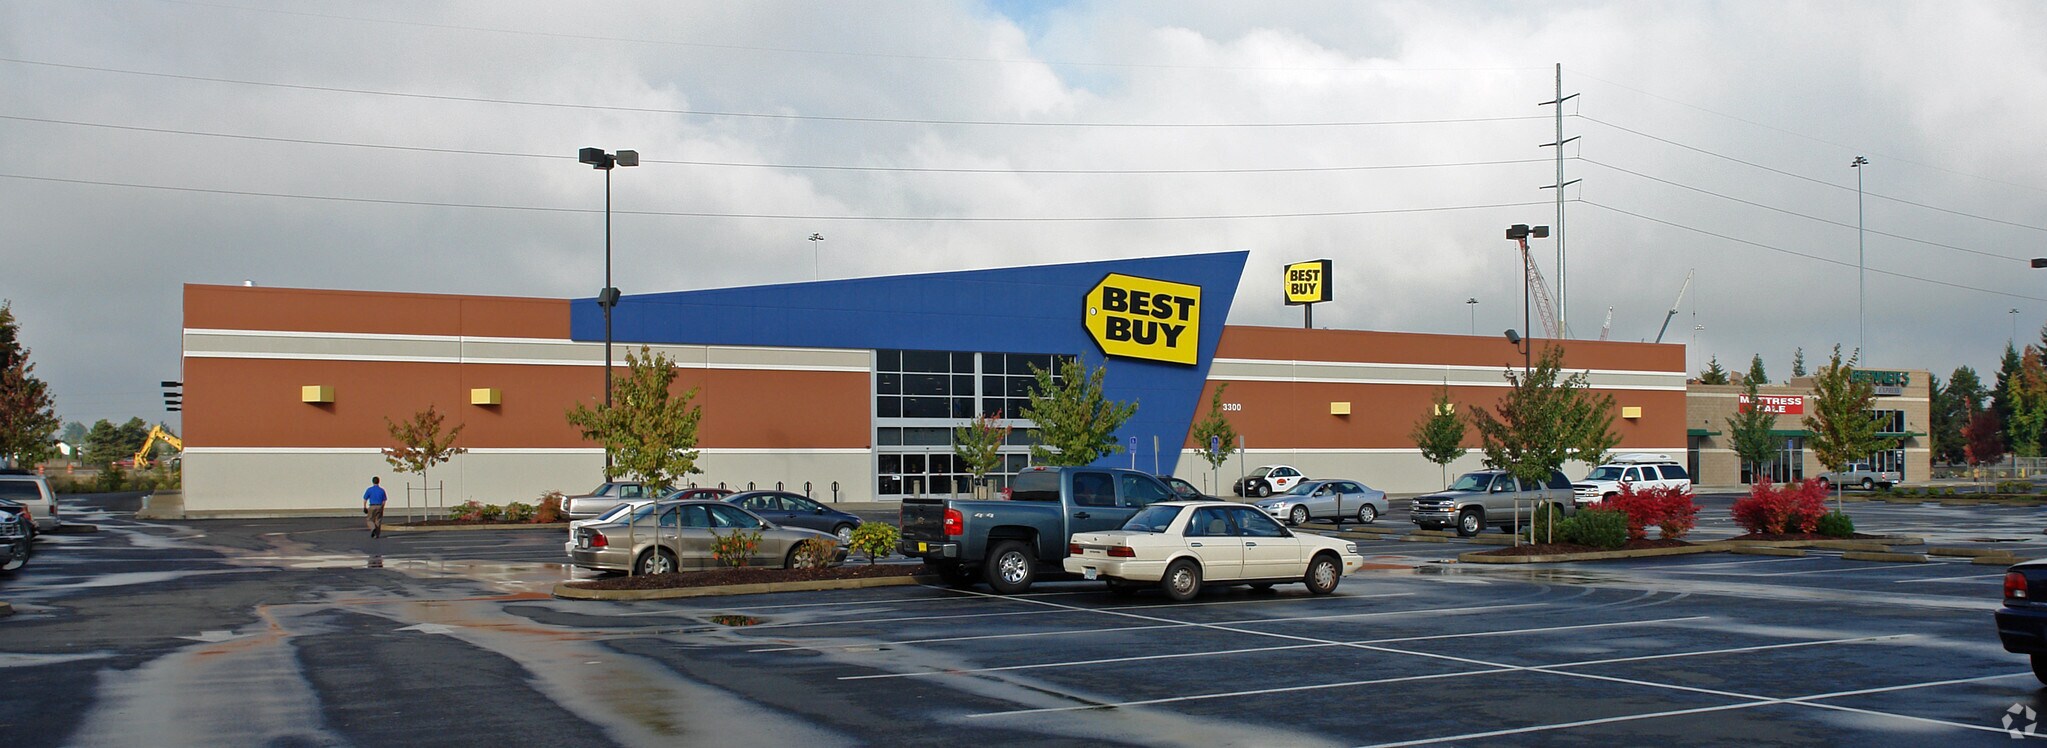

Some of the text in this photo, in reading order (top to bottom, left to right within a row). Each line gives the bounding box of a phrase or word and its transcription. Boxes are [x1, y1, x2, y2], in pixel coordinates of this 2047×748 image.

[1290, 269, 1320, 282] BEST
[1291, 283, 1317, 295] BUY
[1102, 286, 1196, 322] BEST
[1105, 315, 1187, 349] BUY
[1739, 395, 1802, 406] MTTRESS
[1222, 403, 1242, 411] 3300
